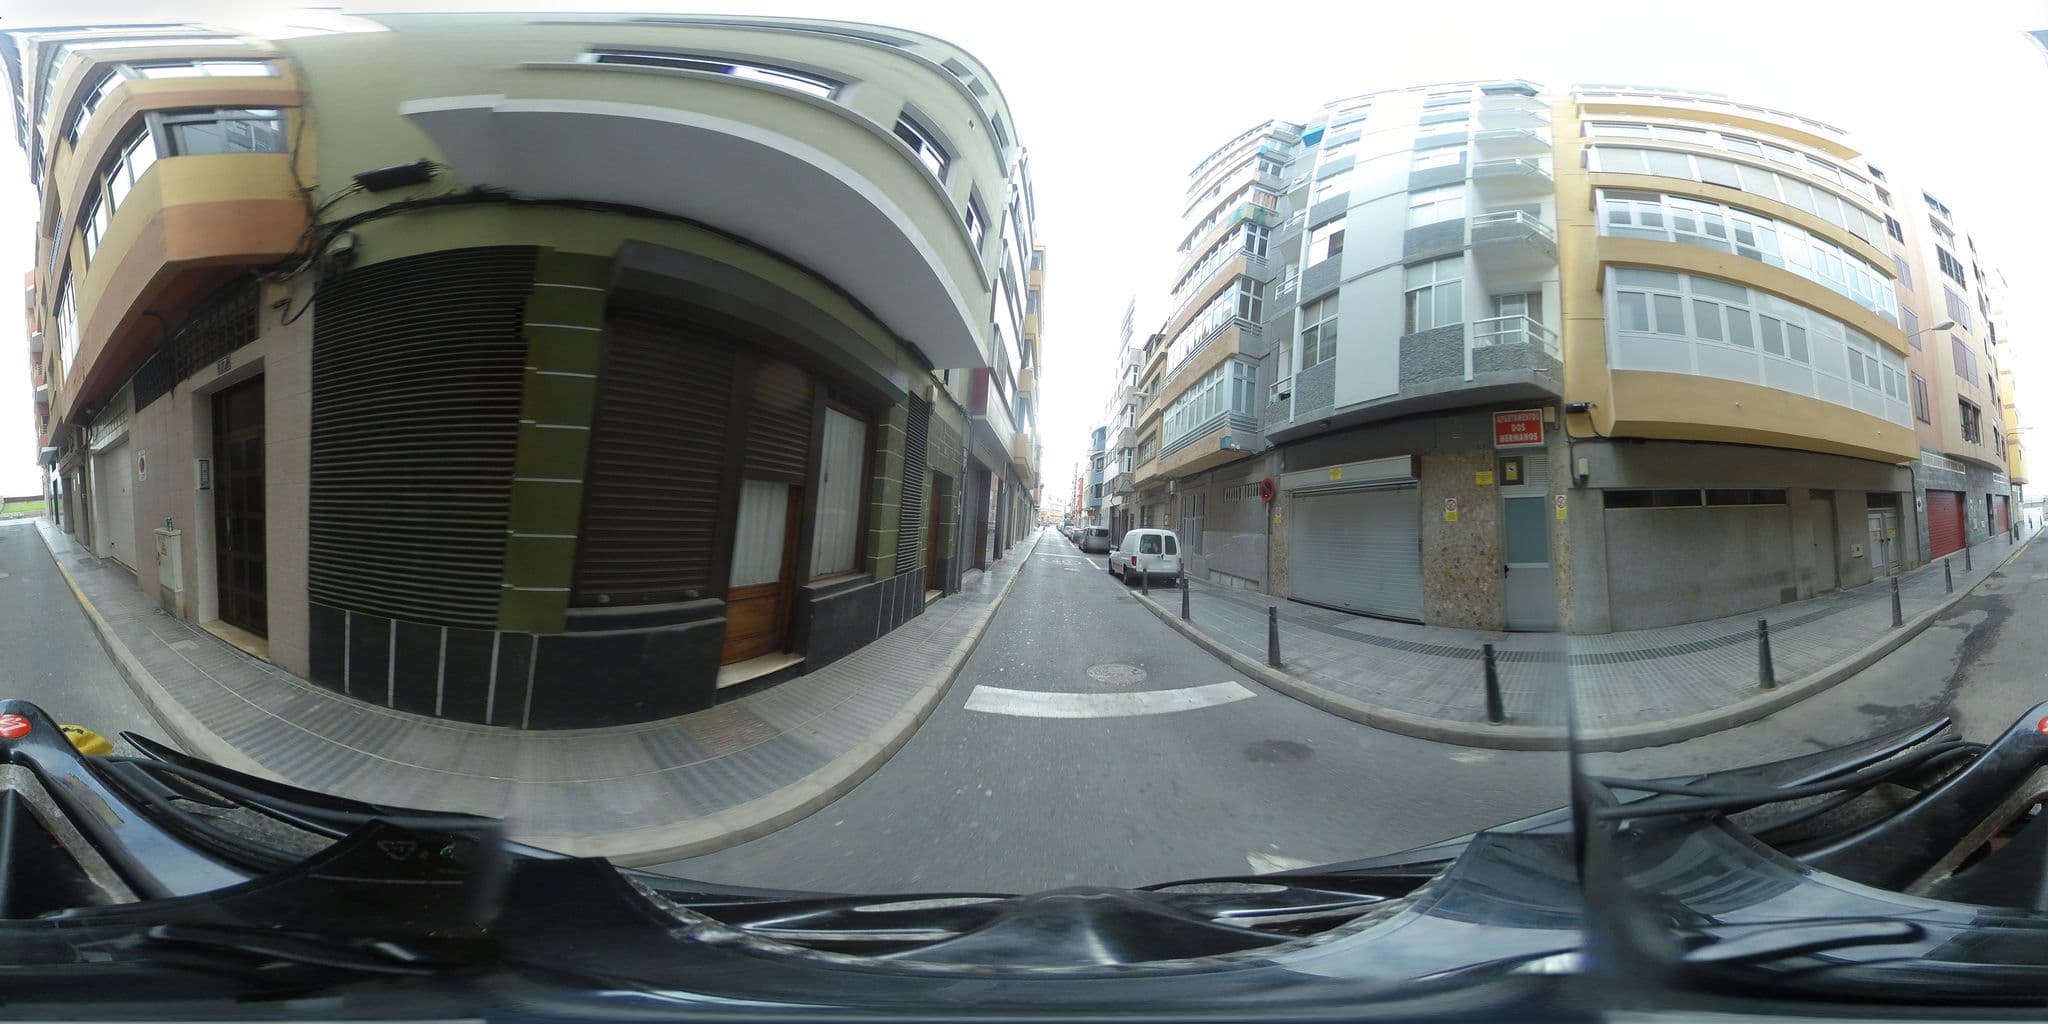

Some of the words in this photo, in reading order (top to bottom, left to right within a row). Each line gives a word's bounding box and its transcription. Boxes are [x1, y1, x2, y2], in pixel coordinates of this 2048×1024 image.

[1497, 412, 1539, 422] APARTAMENTOS
[1511, 423, 1526, 432] DOS
[1500, 432, 1538, 442] HERMANOS
